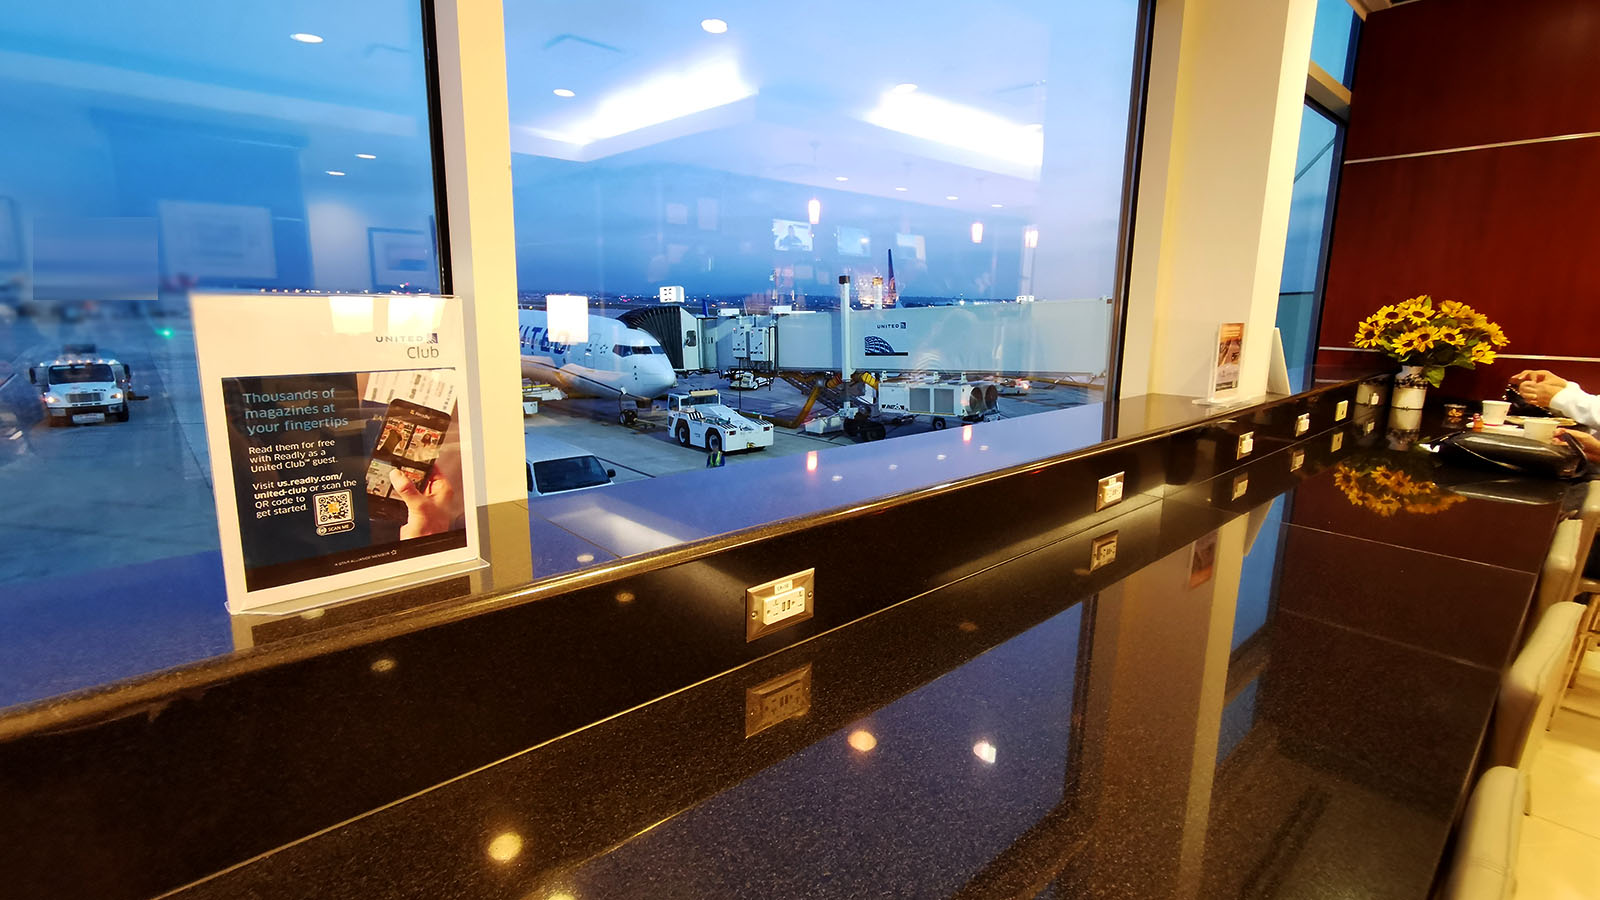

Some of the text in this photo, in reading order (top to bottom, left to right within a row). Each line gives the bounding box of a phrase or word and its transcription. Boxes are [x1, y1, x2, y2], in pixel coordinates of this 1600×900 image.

[407, 346, 440, 359] Club
[242, 388, 336, 404] Thousands of
[245, 404, 335, 420] magazines at
[247, 417, 349, 436] your fingertips
[249, 439, 336, 455] Read them for free
[249, 455, 272, 464] with
[274, 451, 306, 462] Readly
[250, 462, 283, 473] United
[312, 456, 338, 467] guest.
[252, 472, 343, 491] Visit us.readly.com/
[254, 487, 308, 500] united-club
[321, 482, 341, 490] scan
[343, 479, 357, 487] the
[255, 500, 270, 509] QR
[271, 497, 293, 507] code
[256, 508, 271, 519] get
